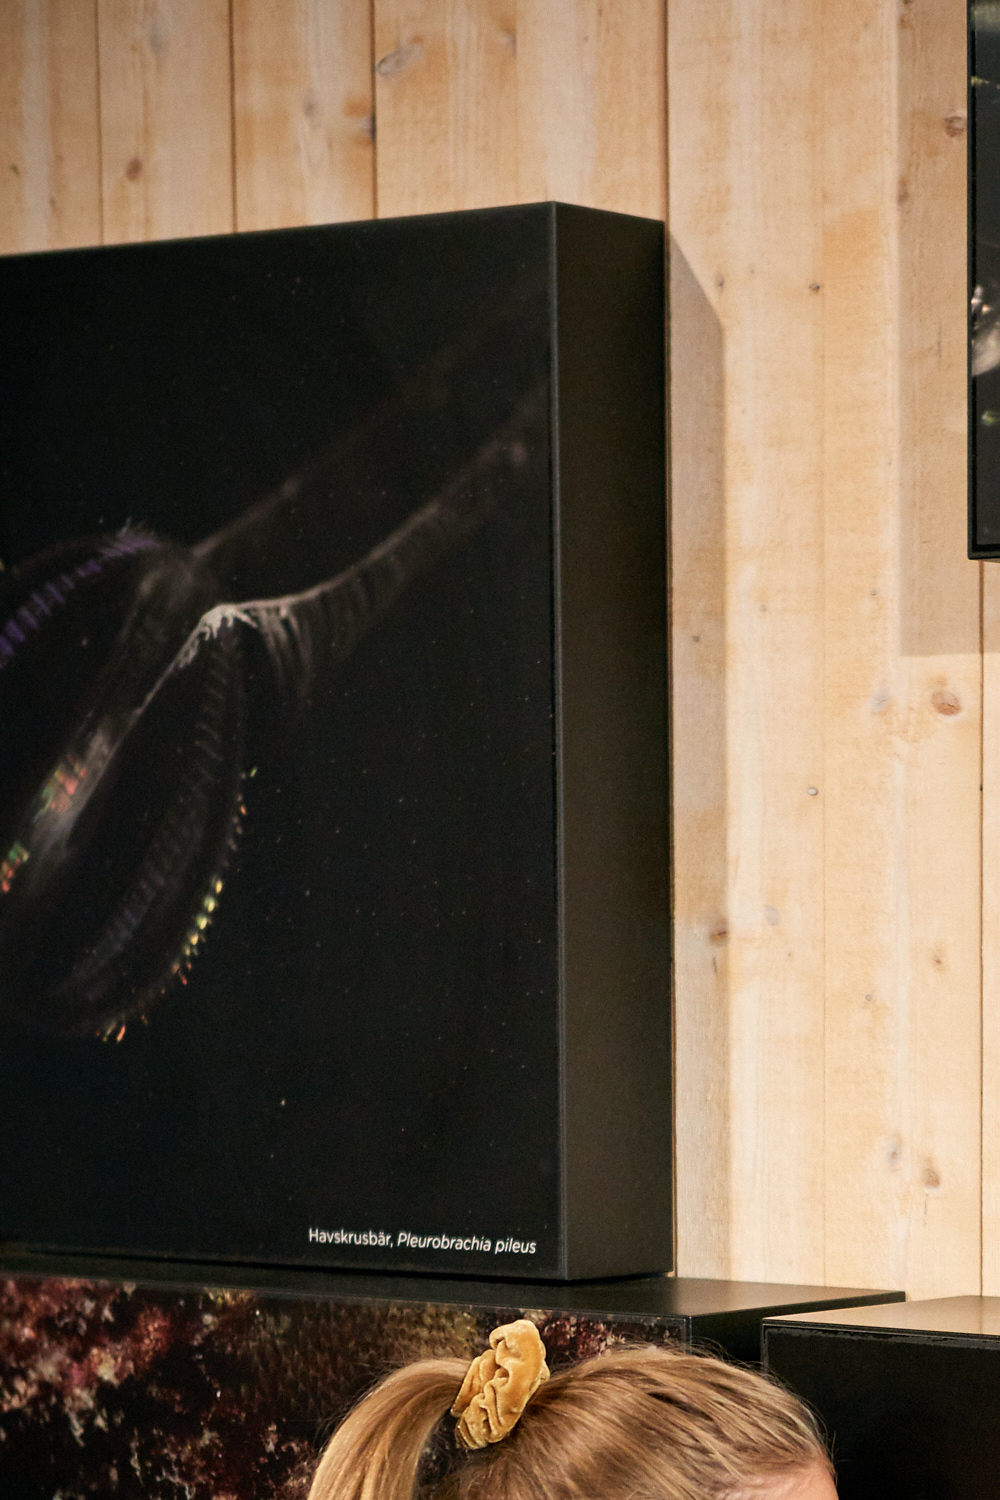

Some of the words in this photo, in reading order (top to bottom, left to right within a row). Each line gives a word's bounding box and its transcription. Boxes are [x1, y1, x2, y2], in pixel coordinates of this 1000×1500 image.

[308, 1227, 394, 1249] Havskrusbär,
[396, 1231, 492, 1252] Pleurobrachia
[494, 1237, 538, 1255] pileus
